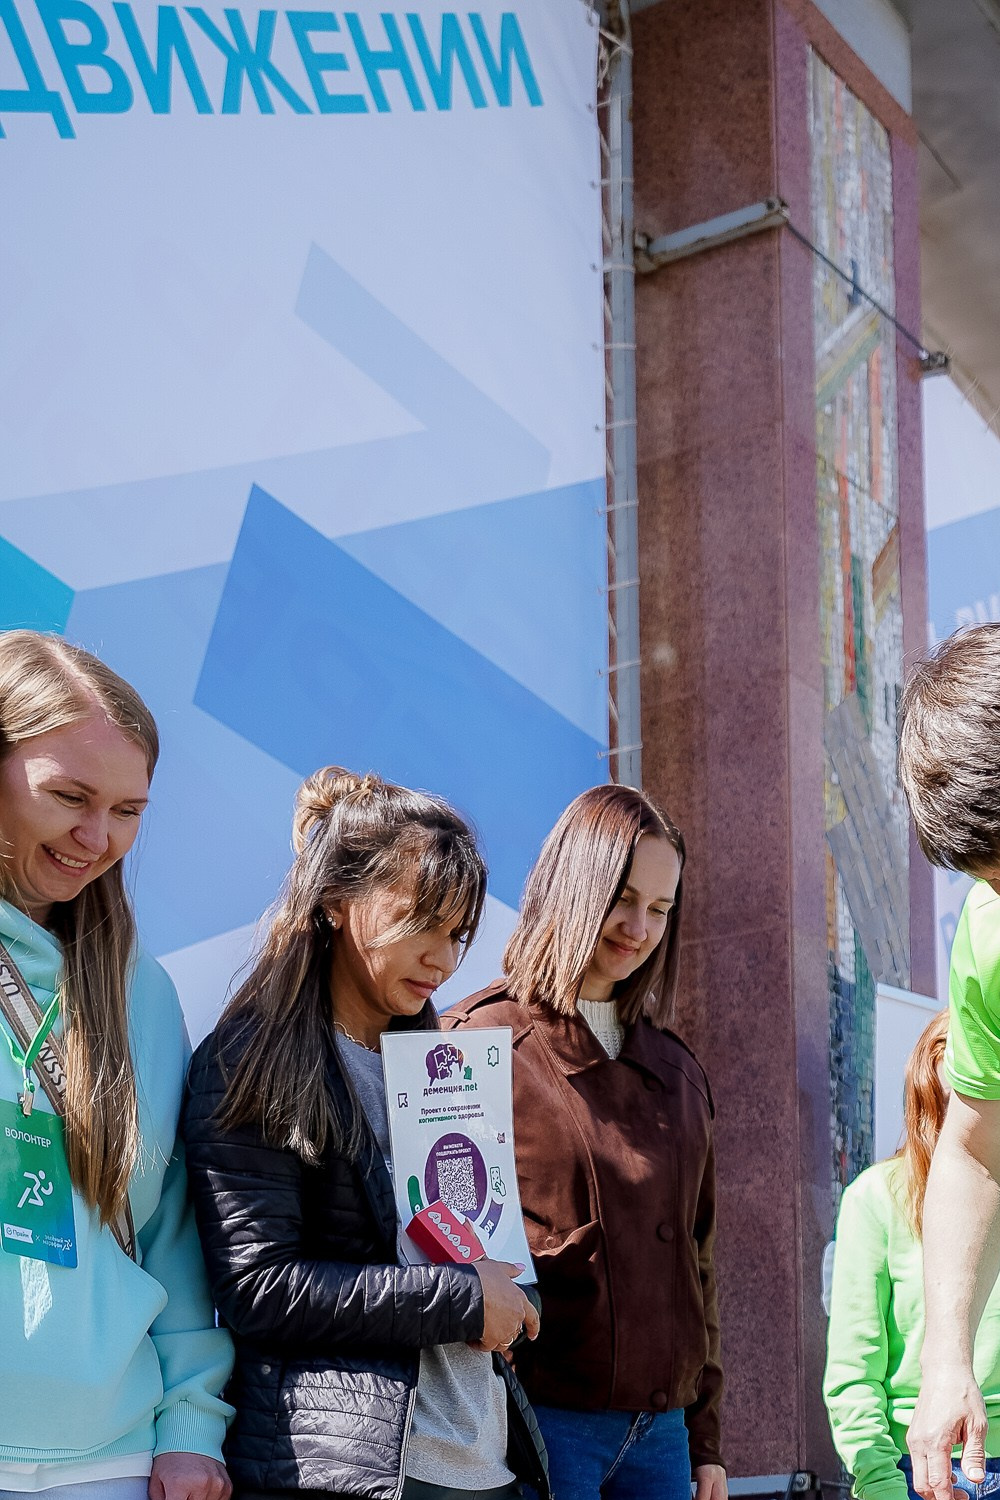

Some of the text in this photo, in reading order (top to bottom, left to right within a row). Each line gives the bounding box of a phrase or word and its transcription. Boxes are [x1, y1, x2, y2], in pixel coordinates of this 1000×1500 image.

[0, 0, 544, 139] ДВИЖЕНИИ
[423, 1082, 478, 1097] деменция.net
[421, 1107, 442, 1116] Проект
[4, 1126, 52, 1149] ВОЛОНТЕР
